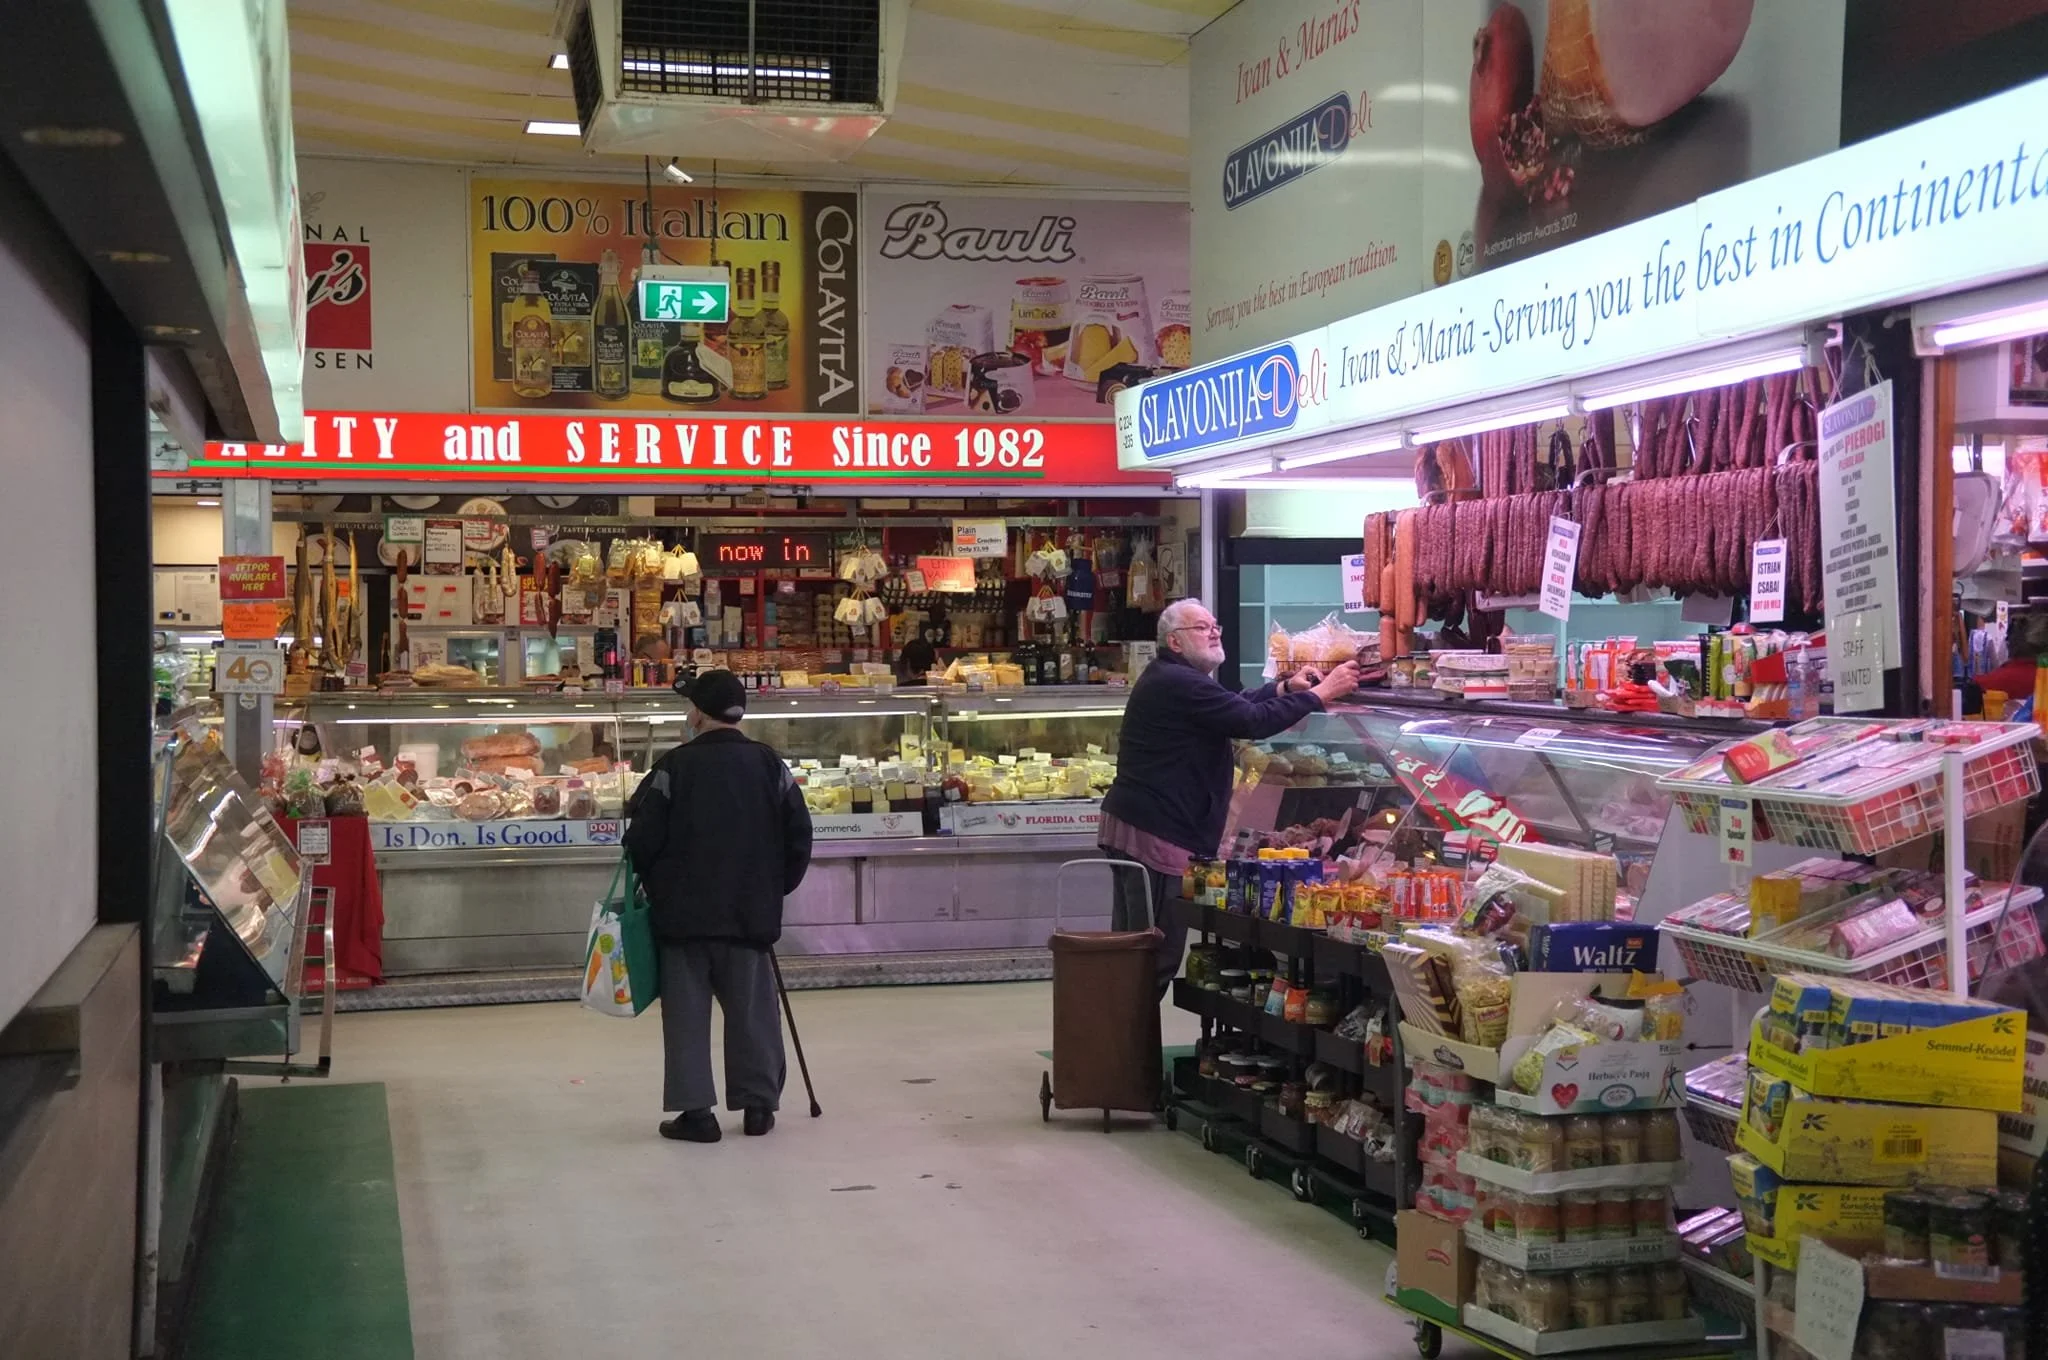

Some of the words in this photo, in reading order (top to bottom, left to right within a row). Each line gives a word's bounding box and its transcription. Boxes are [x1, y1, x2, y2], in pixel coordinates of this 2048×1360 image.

[1236, 57, 1271, 104] Ivan
[1276, 36, 1291, 79] &
[1296, 0, 1361, 70] Maria's
[1226, 117, 1322, 203] SLAVONIJA
[1318, 90, 1373, 149] Deli
[481, 194, 609, 236] 100%
[620, 198, 790, 242] Italian
[880, 201, 1077, 264] Bauli
[1483, 236, 1515, 256] Australian
[1517, 230, 1533, 244] Ham
[1534, 219, 1560, 239] Awards
[1561, 212, 1578, 231] 2012
[1205, 301, 1235, 332] Serving
[1236, 299, 1251, 328] you
[1253, 284, 1266, 313] the
[1269, 280, 1286, 307] best
[1288, 276, 1298, 300] in
[1300, 261, 1345, 298] European
[1348, 240, 1398, 279] tradition.
[1339, 344, 1380, 389] Ivan
[1411, 307, 1476, 371] Maria
[1583, 275, 1634, 346] you
[1642, 239, 1686, 310] the
[1697, 223, 1757, 292] best
[1770, 205, 1804, 271] in
[816, 205, 855, 407] COLAVITA
[1141, 363, 1264, 449] SLAVONIJA
[1255, 347, 1328, 419] Deli
[1123, 415, 1132, 431] 234
[443, 421, 522, 462] and
[566, 421, 793, 467] SERVICE
[833, 426, 931, 468] Since
[955, 428, 1044, 469] 1982
[1844, 419, 1885, 454] PIEROGI
[957, 526, 976, 535] Plain
[719, 545, 764, 562] now
[783, 538, 810, 561] in
[229, 573, 278, 583] AVAILABLE
[236, 562, 271, 572] EFTPOS
[1757, 561, 1781, 575] ISTRIAN
[242, 582, 265, 592] HERE
[1344, 601, 1362, 610] BEEF
[1842, 639, 1865, 658] STAFF
[1840, 667, 1873, 687] WANTED
[589, 822, 617, 833] DON
[1025, 814, 1075, 826] FLORIDIA
[384, 826, 404, 848] Is
[410, 825, 466, 848] Don.
[476, 825, 496, 846] Is
[501, 823, 574, 846] Good.
[1573, 945, 1637, 967] Waltz
